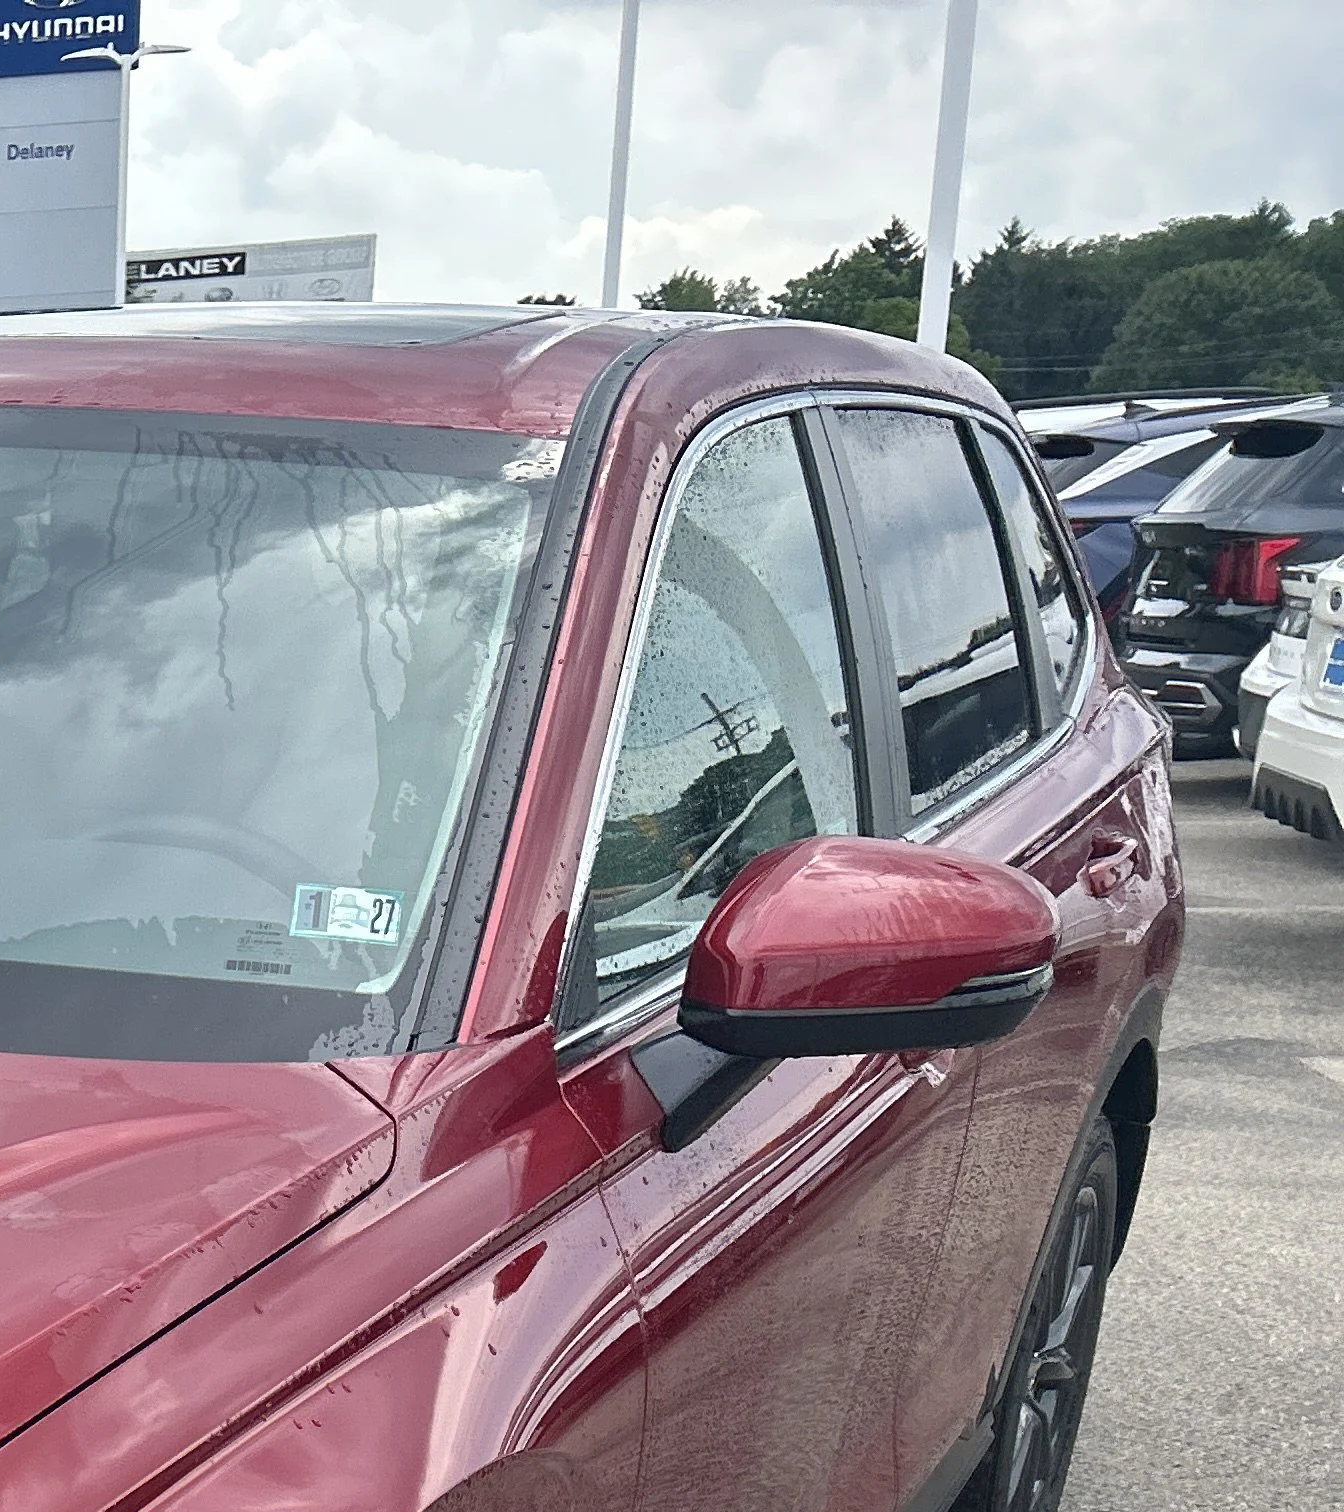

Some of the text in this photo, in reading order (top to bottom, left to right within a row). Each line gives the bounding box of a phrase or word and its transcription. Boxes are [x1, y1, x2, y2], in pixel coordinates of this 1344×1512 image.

[6, 142, 76, 162] Delaney
[127, 255, 244, 281] LANEY
[369, 897, 397, 935] 27
